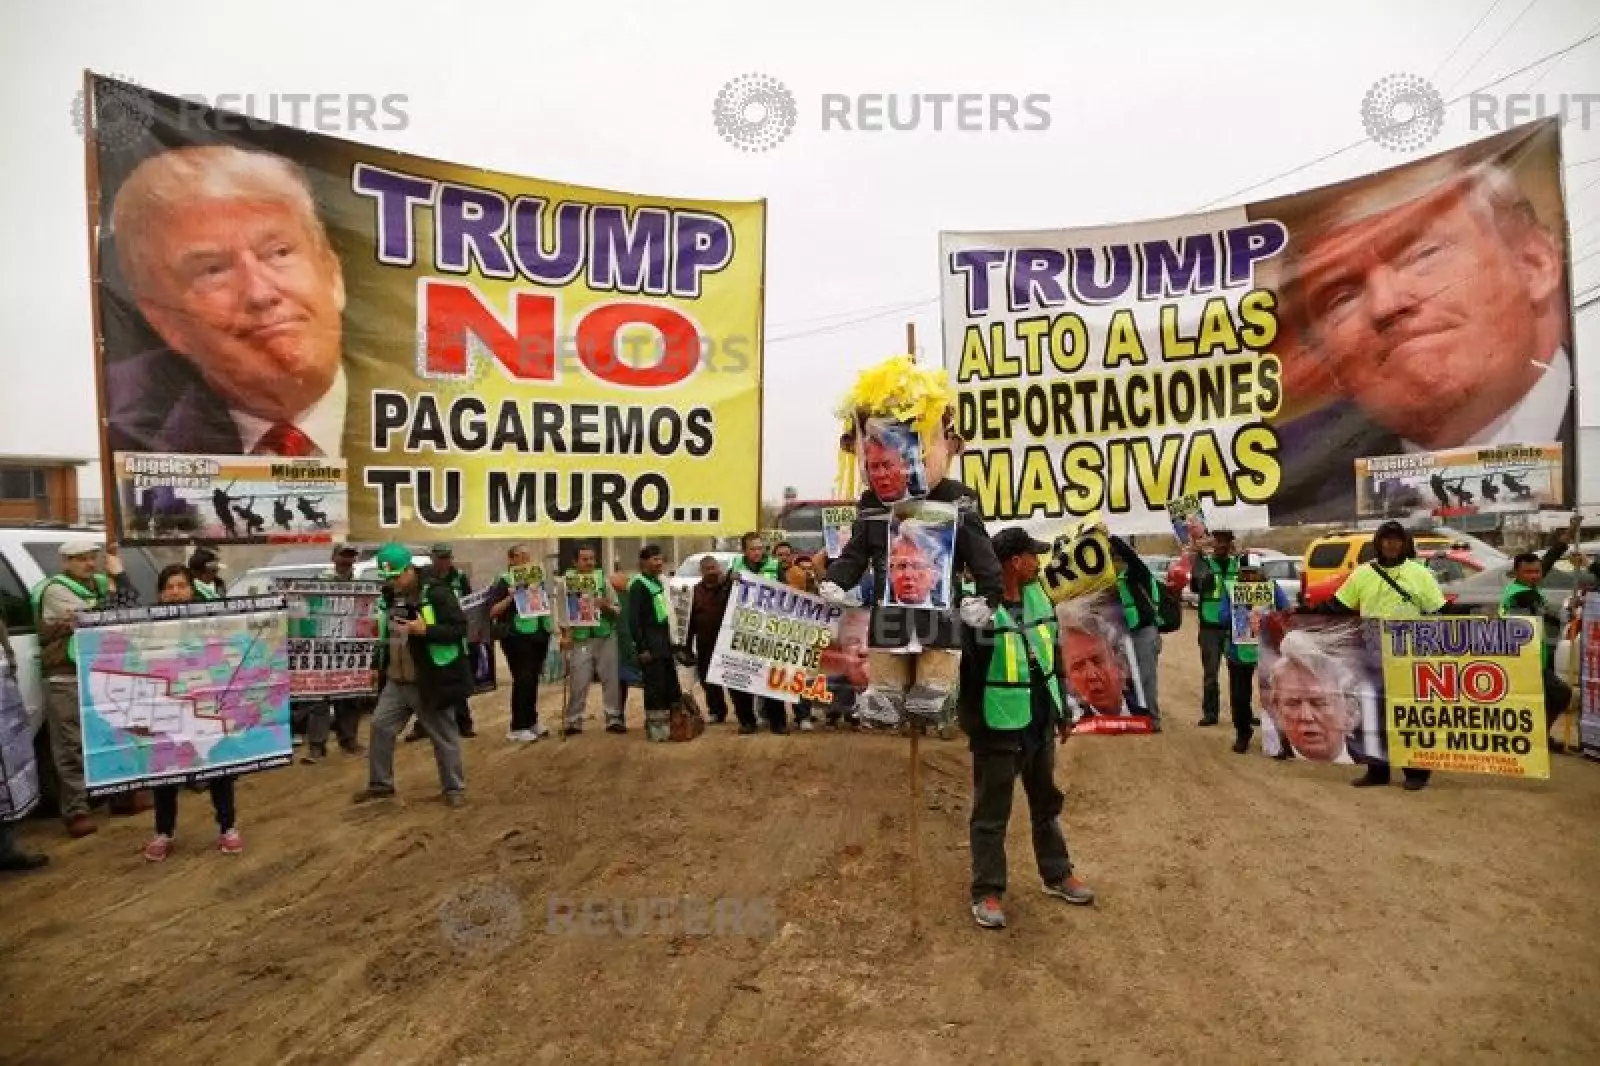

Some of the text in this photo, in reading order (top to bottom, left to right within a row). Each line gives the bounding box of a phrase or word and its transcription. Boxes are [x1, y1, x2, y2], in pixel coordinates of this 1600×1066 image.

[353, 162, 734, 298] TRUMP
[950, 219, 1288, 318] TRUMP
[418, 278, 702, 388] NO
[957, 289, 1278, 383] ALTO A LAS
[958, 354, 1282, 441] DEPORTACIONES
[373, 391, 713, 456] PAGAREMOS
[270, 463, 341, 478] Migrante
[962, 422, 1281, 520] MASIVAS
[365, 469, 720, 526] TU MURO...
[739, 578, 843, 623] TRUMP
[1233, 591, 1272, 603] MURO
[731, 631, 821, 669] ENEMIGOS DE
[765, 616, 831, 649] SOMOS
[1385, 618, 1534, 658] TRUMP
[1413, 660, 1509, 704] NO
[1394, 705, 1533, 734] PAGAREMOS
[1399, 731, 1531, 755] TU MURO
